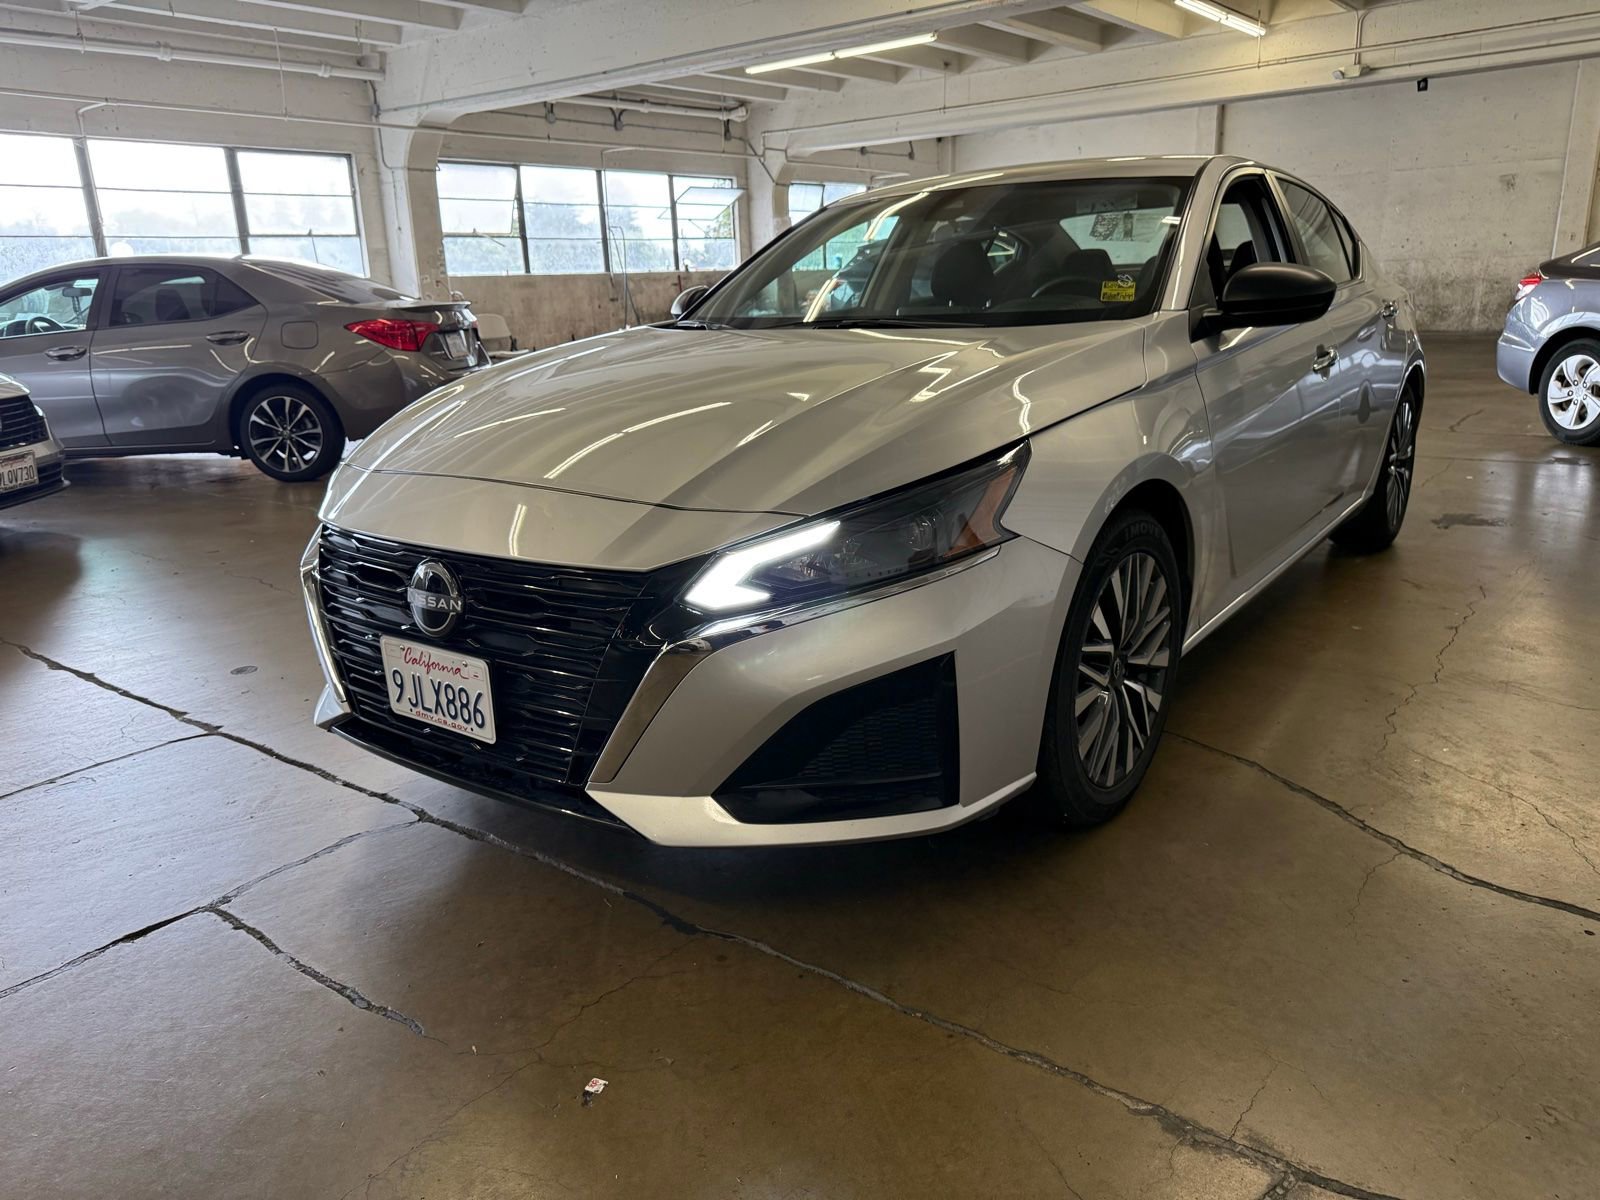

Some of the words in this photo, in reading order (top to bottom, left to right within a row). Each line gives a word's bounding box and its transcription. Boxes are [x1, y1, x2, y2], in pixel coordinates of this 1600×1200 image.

[408, 587, 461, 611] NISSAN
[404, 647, 469, 679] California
[392, 668, 485, 728] 9JLX886
[415, 710, 468, 732] dmv.ca.gov
